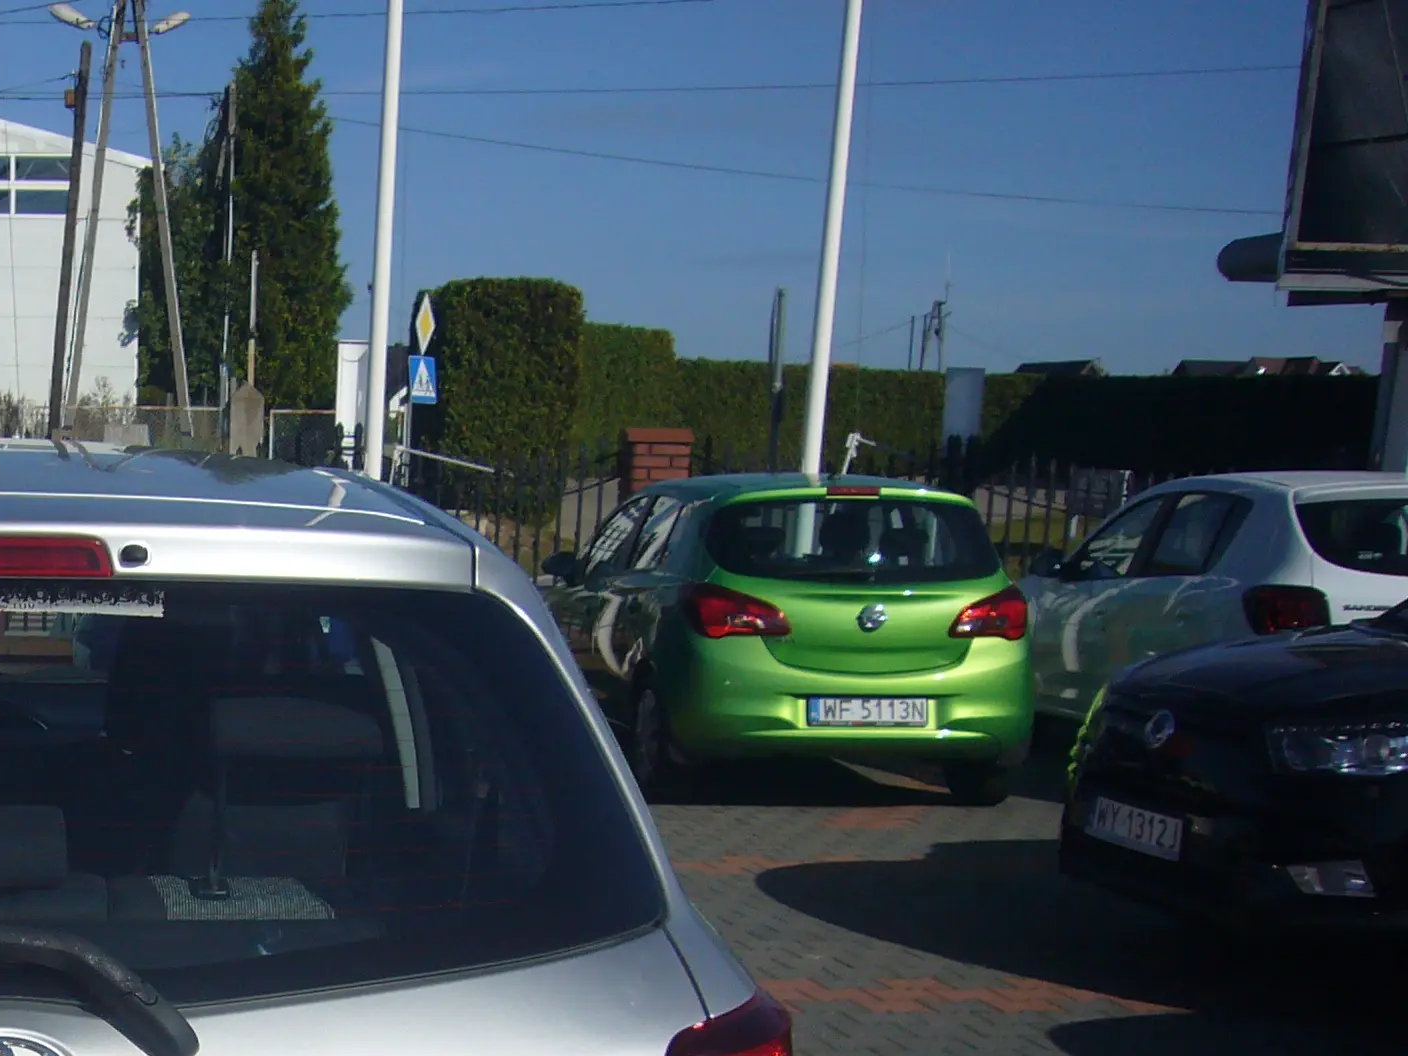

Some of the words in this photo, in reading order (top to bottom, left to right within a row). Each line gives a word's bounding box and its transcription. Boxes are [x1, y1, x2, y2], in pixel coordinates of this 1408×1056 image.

[824, 699, 852, 719] WF
[861, 699, 924, 720] 5113N
[1097, 799, 1121, 832] WY
[1127, 809, 1179, 849] 1312J
